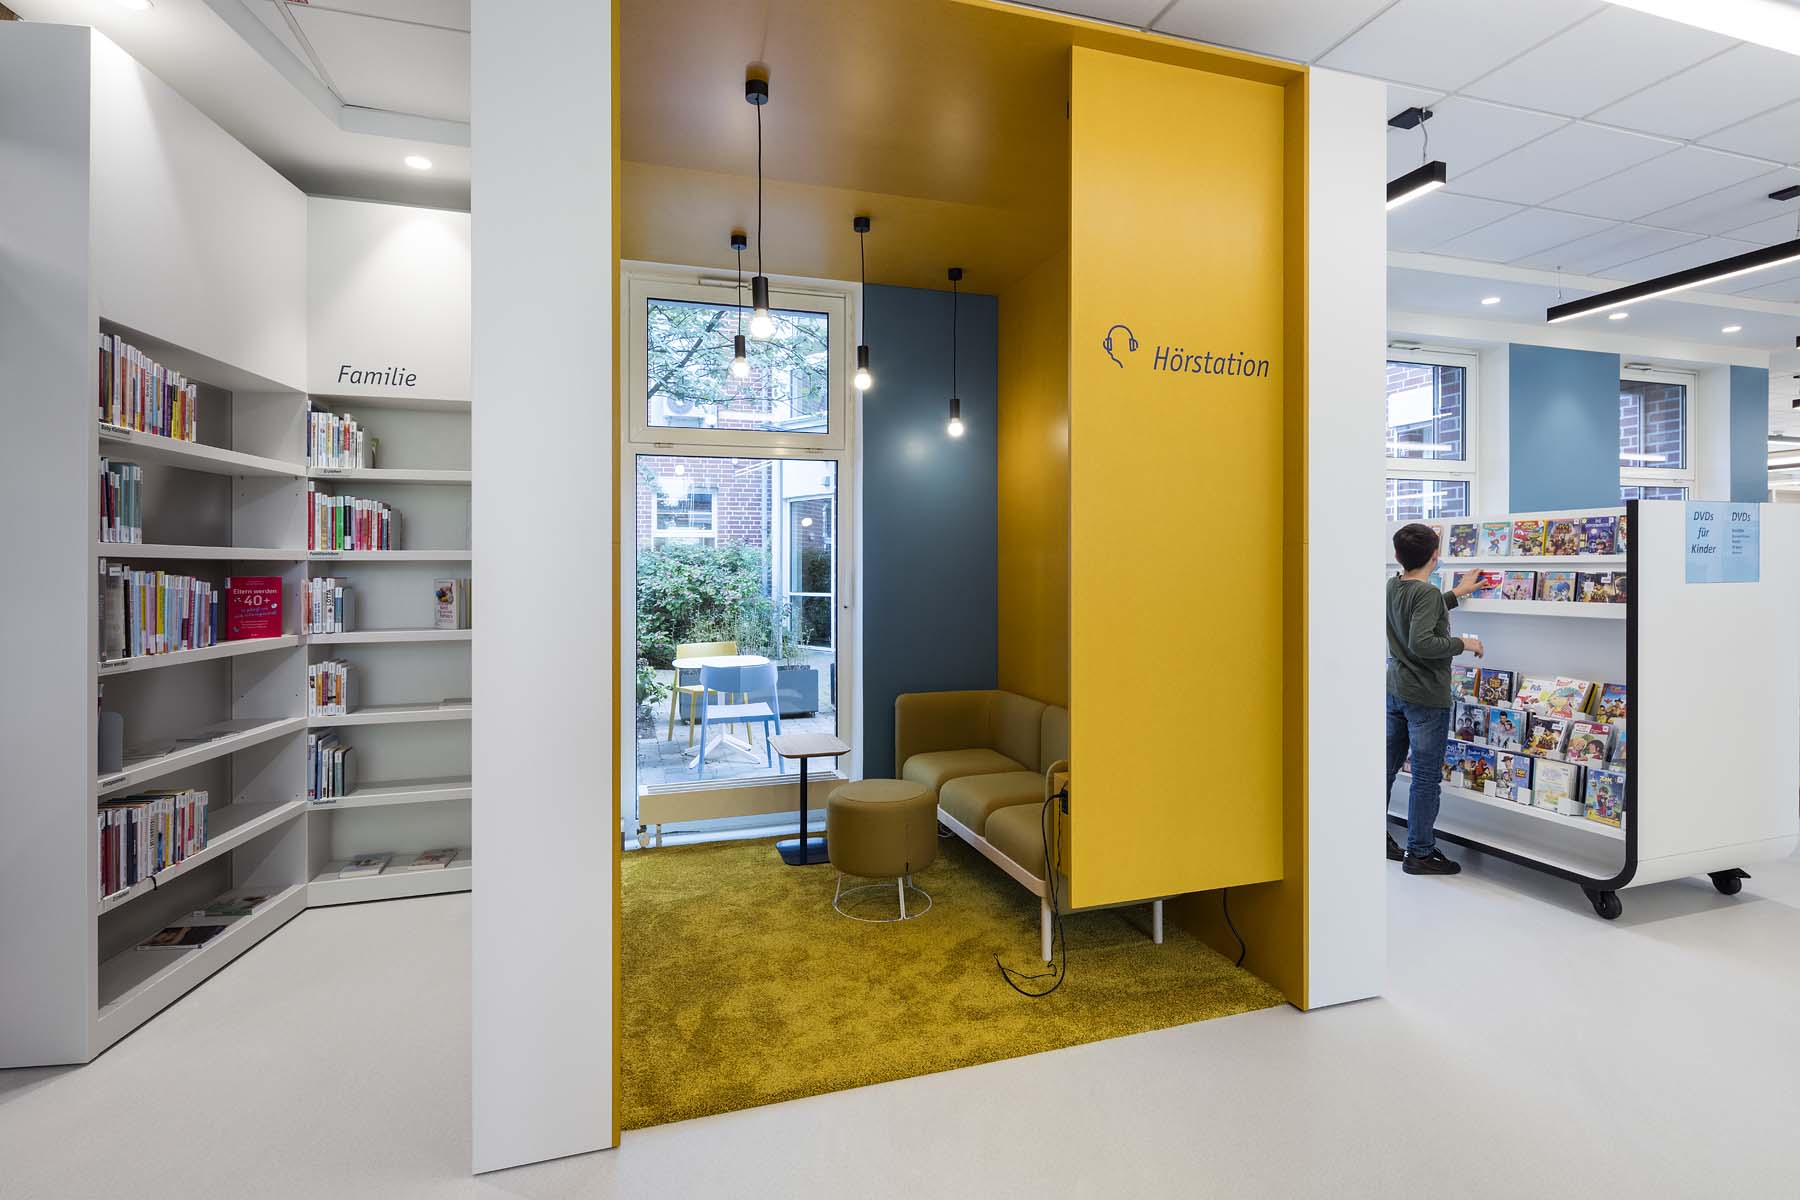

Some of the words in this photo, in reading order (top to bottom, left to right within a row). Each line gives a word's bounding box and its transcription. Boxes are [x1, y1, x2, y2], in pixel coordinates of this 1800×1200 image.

[1153, 345, 1270, 378] Hörstation
[337, 364, 417, 387] Familie
[1693, 511, 1714, 521] DVDs
[1731, 511, 1752, 522] DVDs
[1696, 526, 1710, 540] für
[1690, 543, 1717, 554] Kinder
